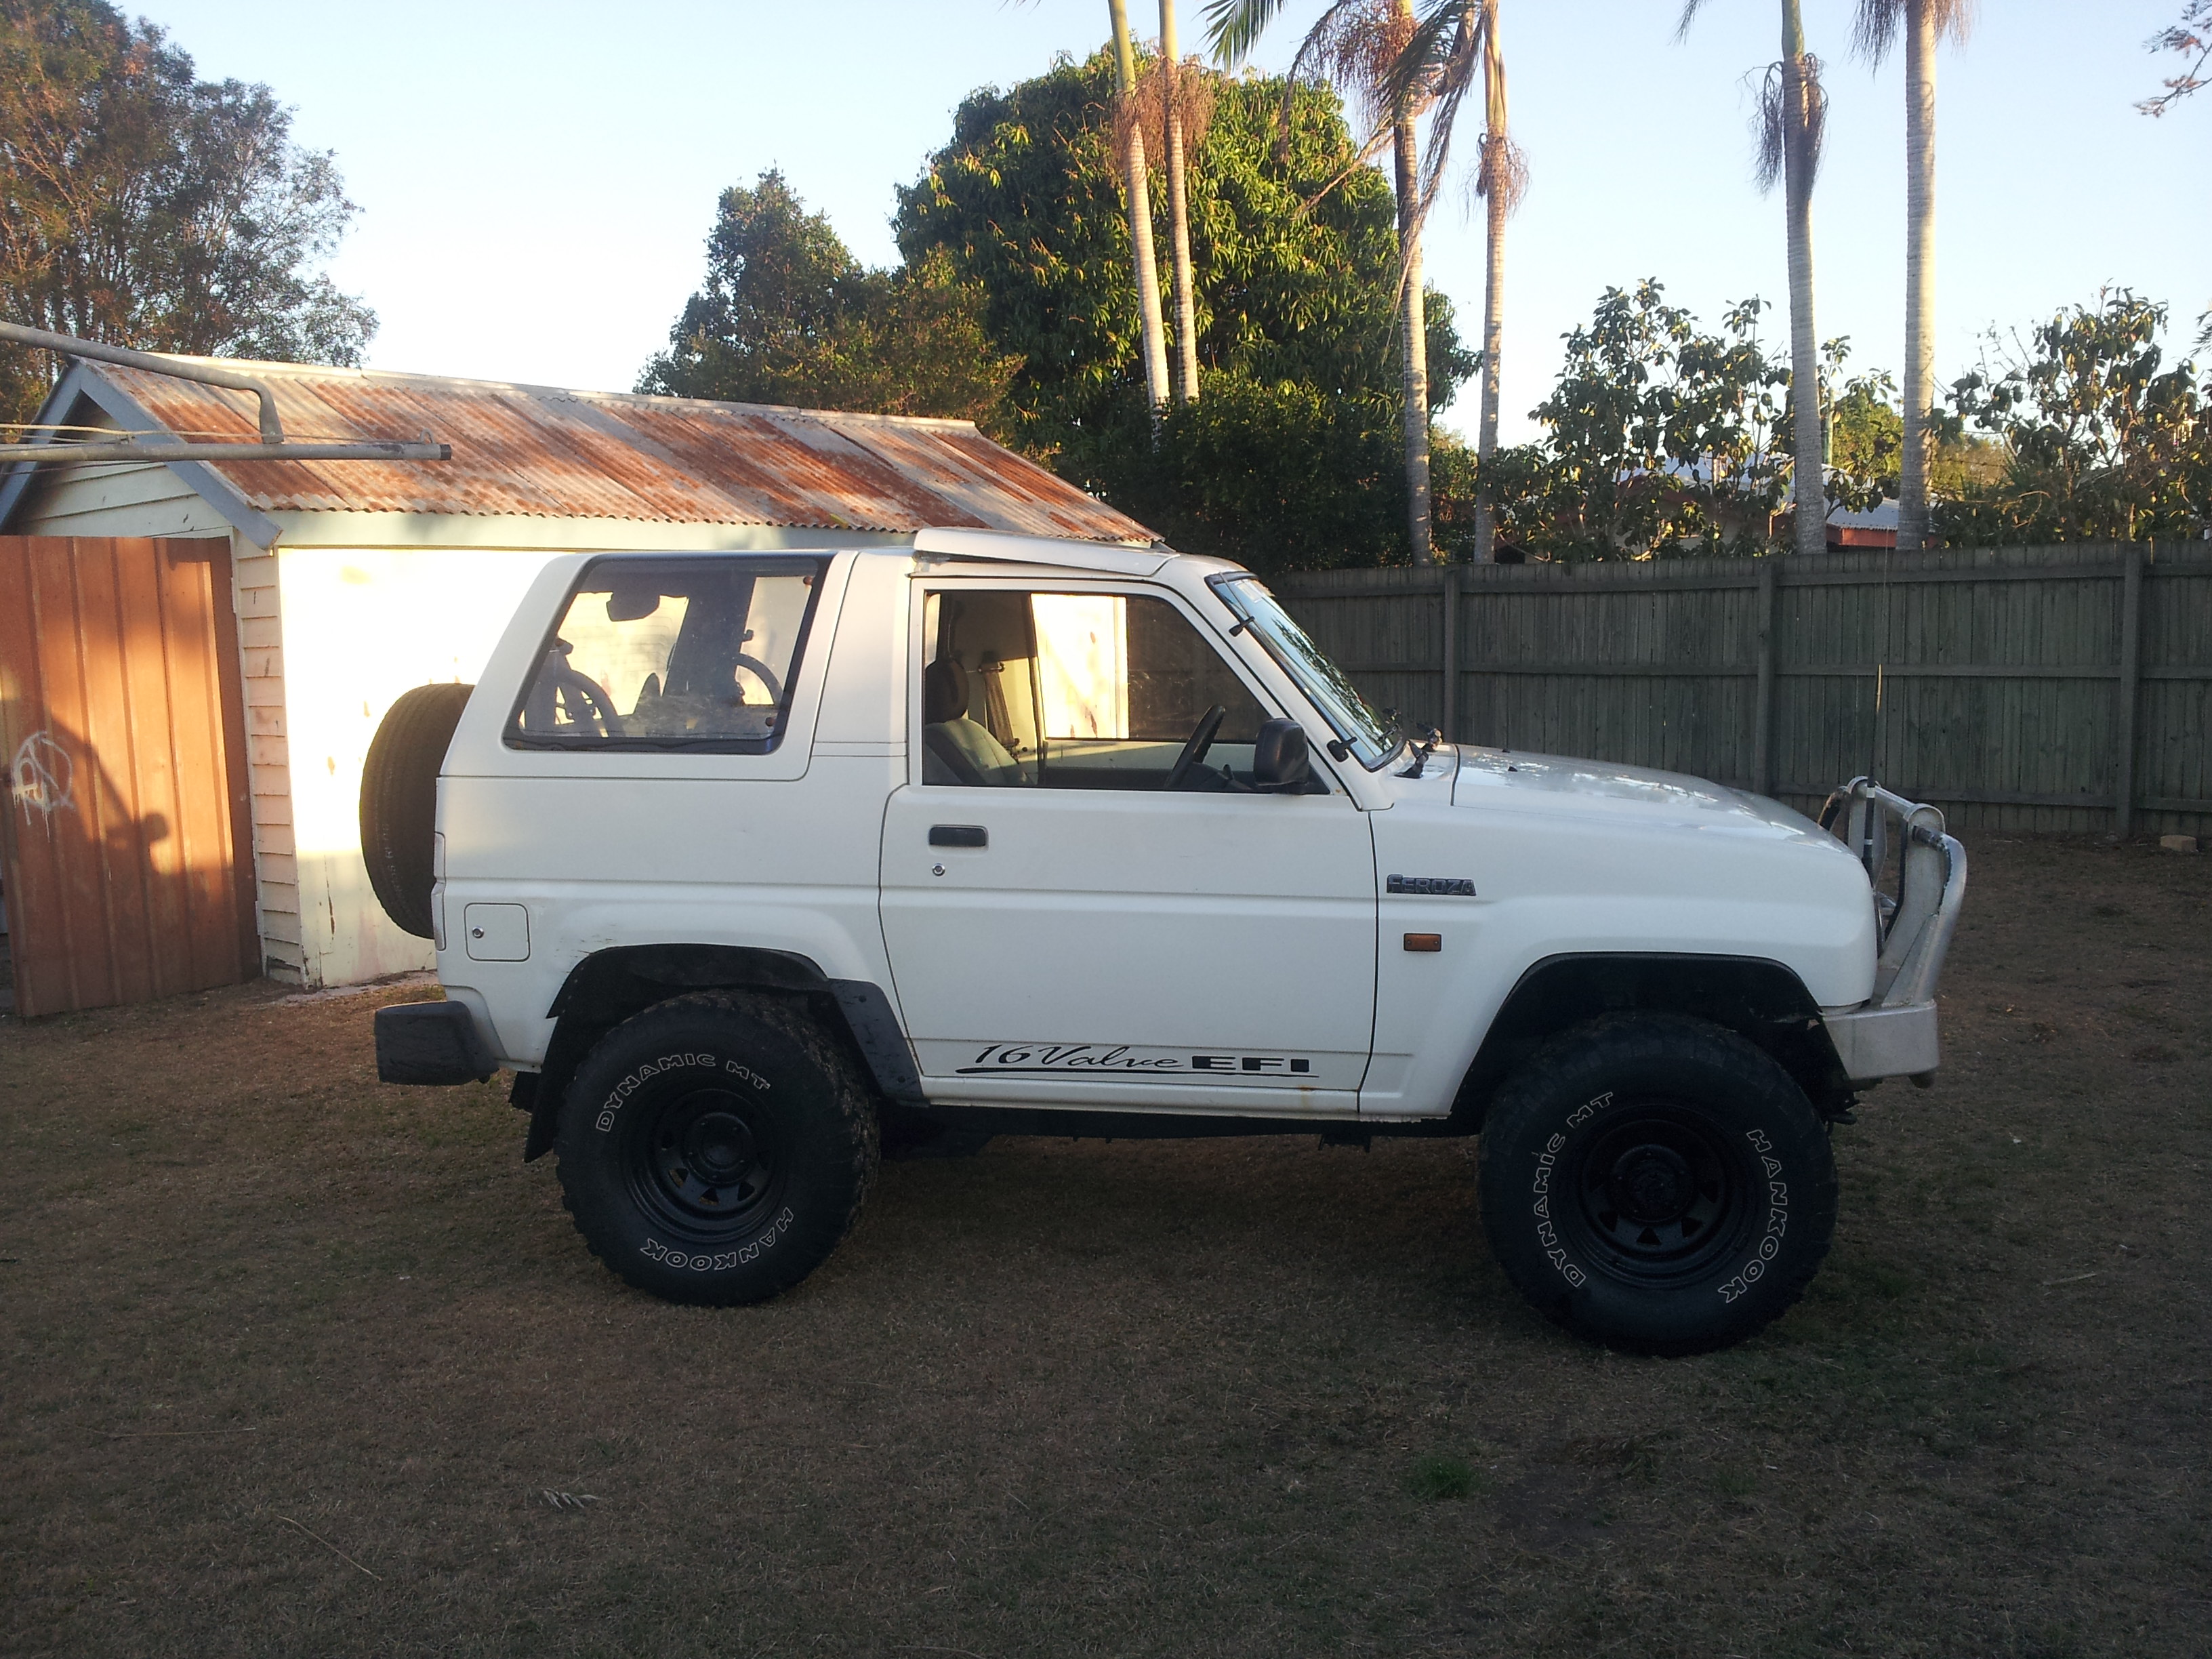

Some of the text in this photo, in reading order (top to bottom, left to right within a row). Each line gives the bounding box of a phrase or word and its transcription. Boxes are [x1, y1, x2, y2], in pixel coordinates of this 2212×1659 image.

[1387, 874, 1477, 896] FEROZA
[596, 1054, 771, 1132] DYNAMIC MT
[1191, 1055, 1309, 1073] EFI
[1534, 1092, 1614, 1288] DYNAMIC MT
[1718, 1129, 1787, 1303] HANKOOK
[640, 1207, 794, 1271] HANKOOK
